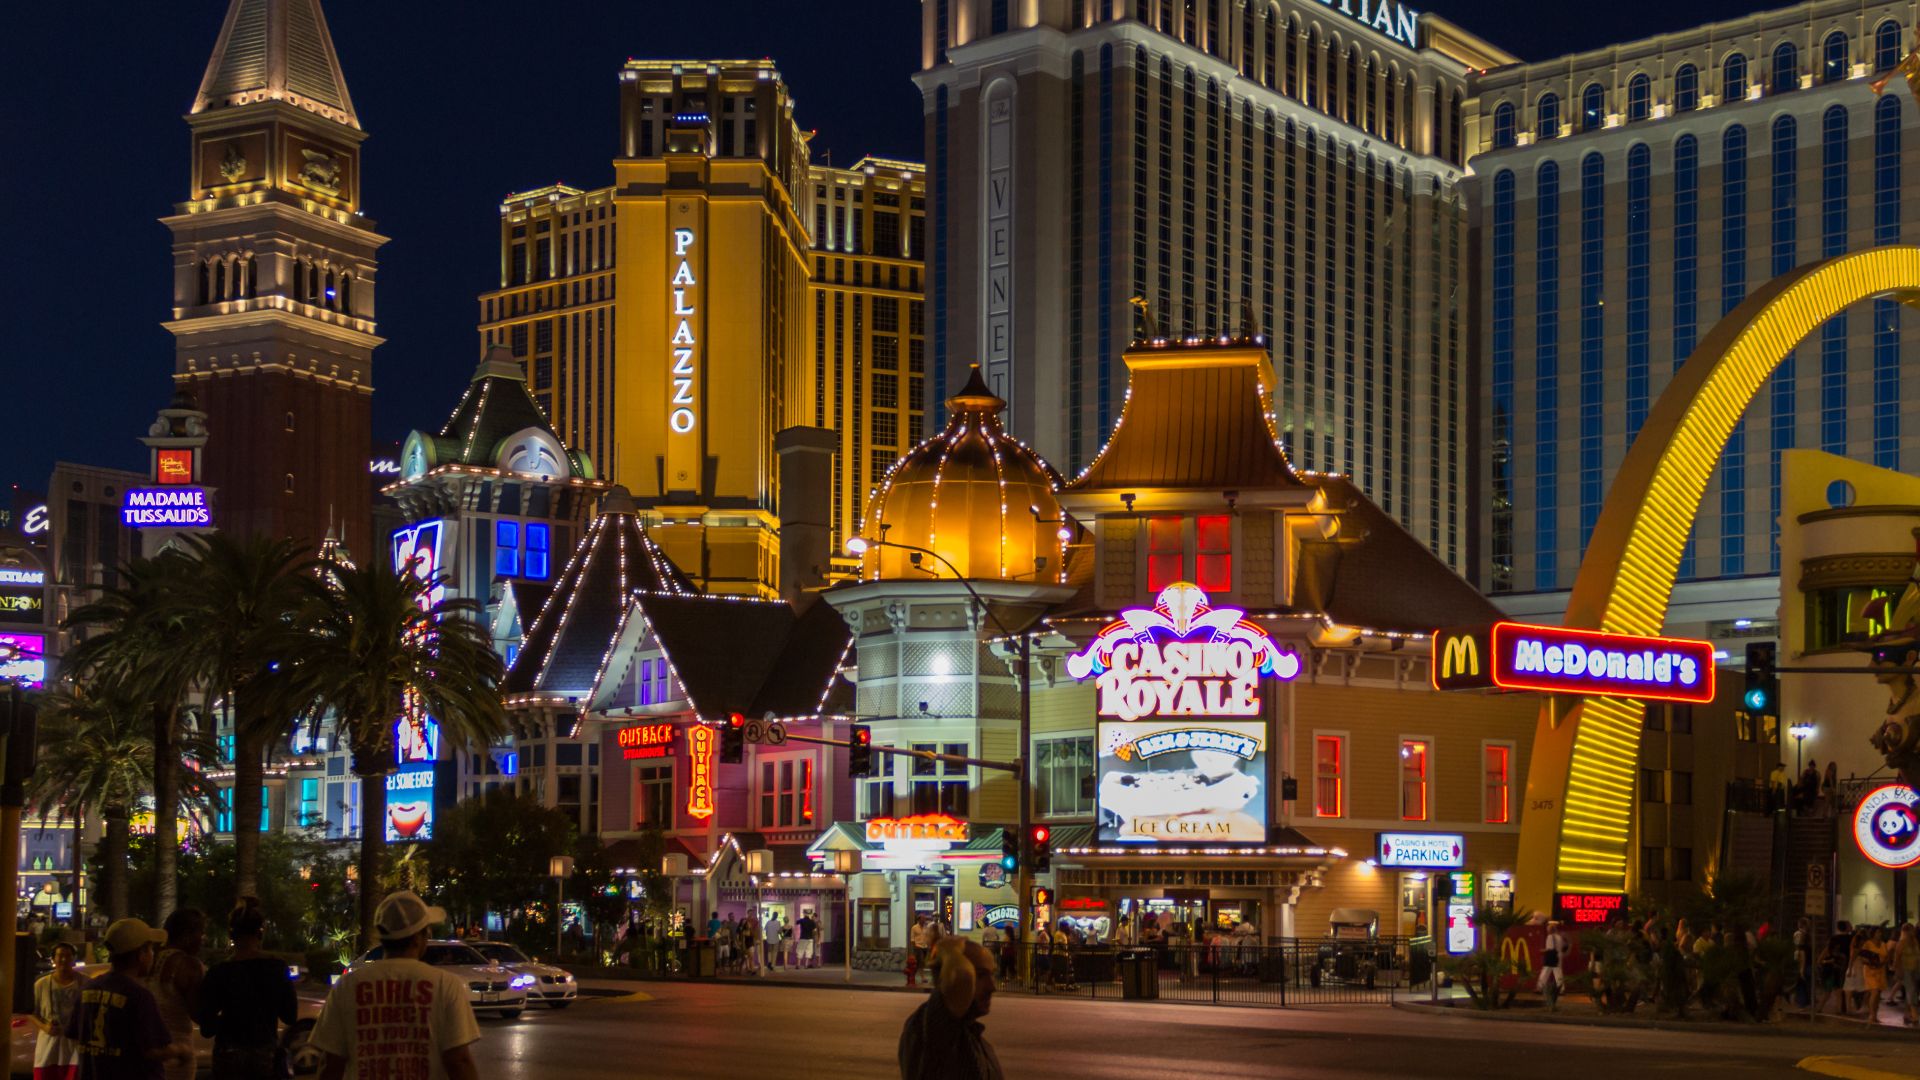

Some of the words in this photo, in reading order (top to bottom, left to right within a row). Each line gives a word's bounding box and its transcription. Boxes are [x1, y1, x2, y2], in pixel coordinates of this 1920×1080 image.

[670, 228, 695, 433] PALAZZO
[129, 491, 204, 506] MADAME
[124, 507, 209, 523] TUSSAUD'S
[1111, 642, 1254, 684] CASINO
[1514, 639, 1697, 684] McDonald's
[1096, 667, 1260, 720] ROYALE
[618, 724, 672, 747] OUTBACK
[695, 729, 707, 809] OUTBACK
[1531, 800, 1554, 810] 3475
[1860, 792, 1889, 824] PANDA
[867, 823, 966, 840] OUTBACK
[1133, 818, 1157, 834] ICE
[1165, 818, 1231, 834] CREAM
[1395, 839, 1421, 847] CASINO
[1428, 840, 1449, 848] HOTEL
[1396, 848, 1449, 862] PARKING
[1583, 895, 1622, 909] CHERRY
[1575, 909, 1608, 923] BERRY
[356, 980, 433, 1006] GIRLS
[357, 1006, 431, 1025] DIRECT
[357, 1028, 377, 1041] TO
[383, 1026, 408, 1039] YOU
[413, 1027, 430, 1039] IN
[358, 1044, 374, 1057] 20
[376, 1042, 429, 1056] MINUTES
